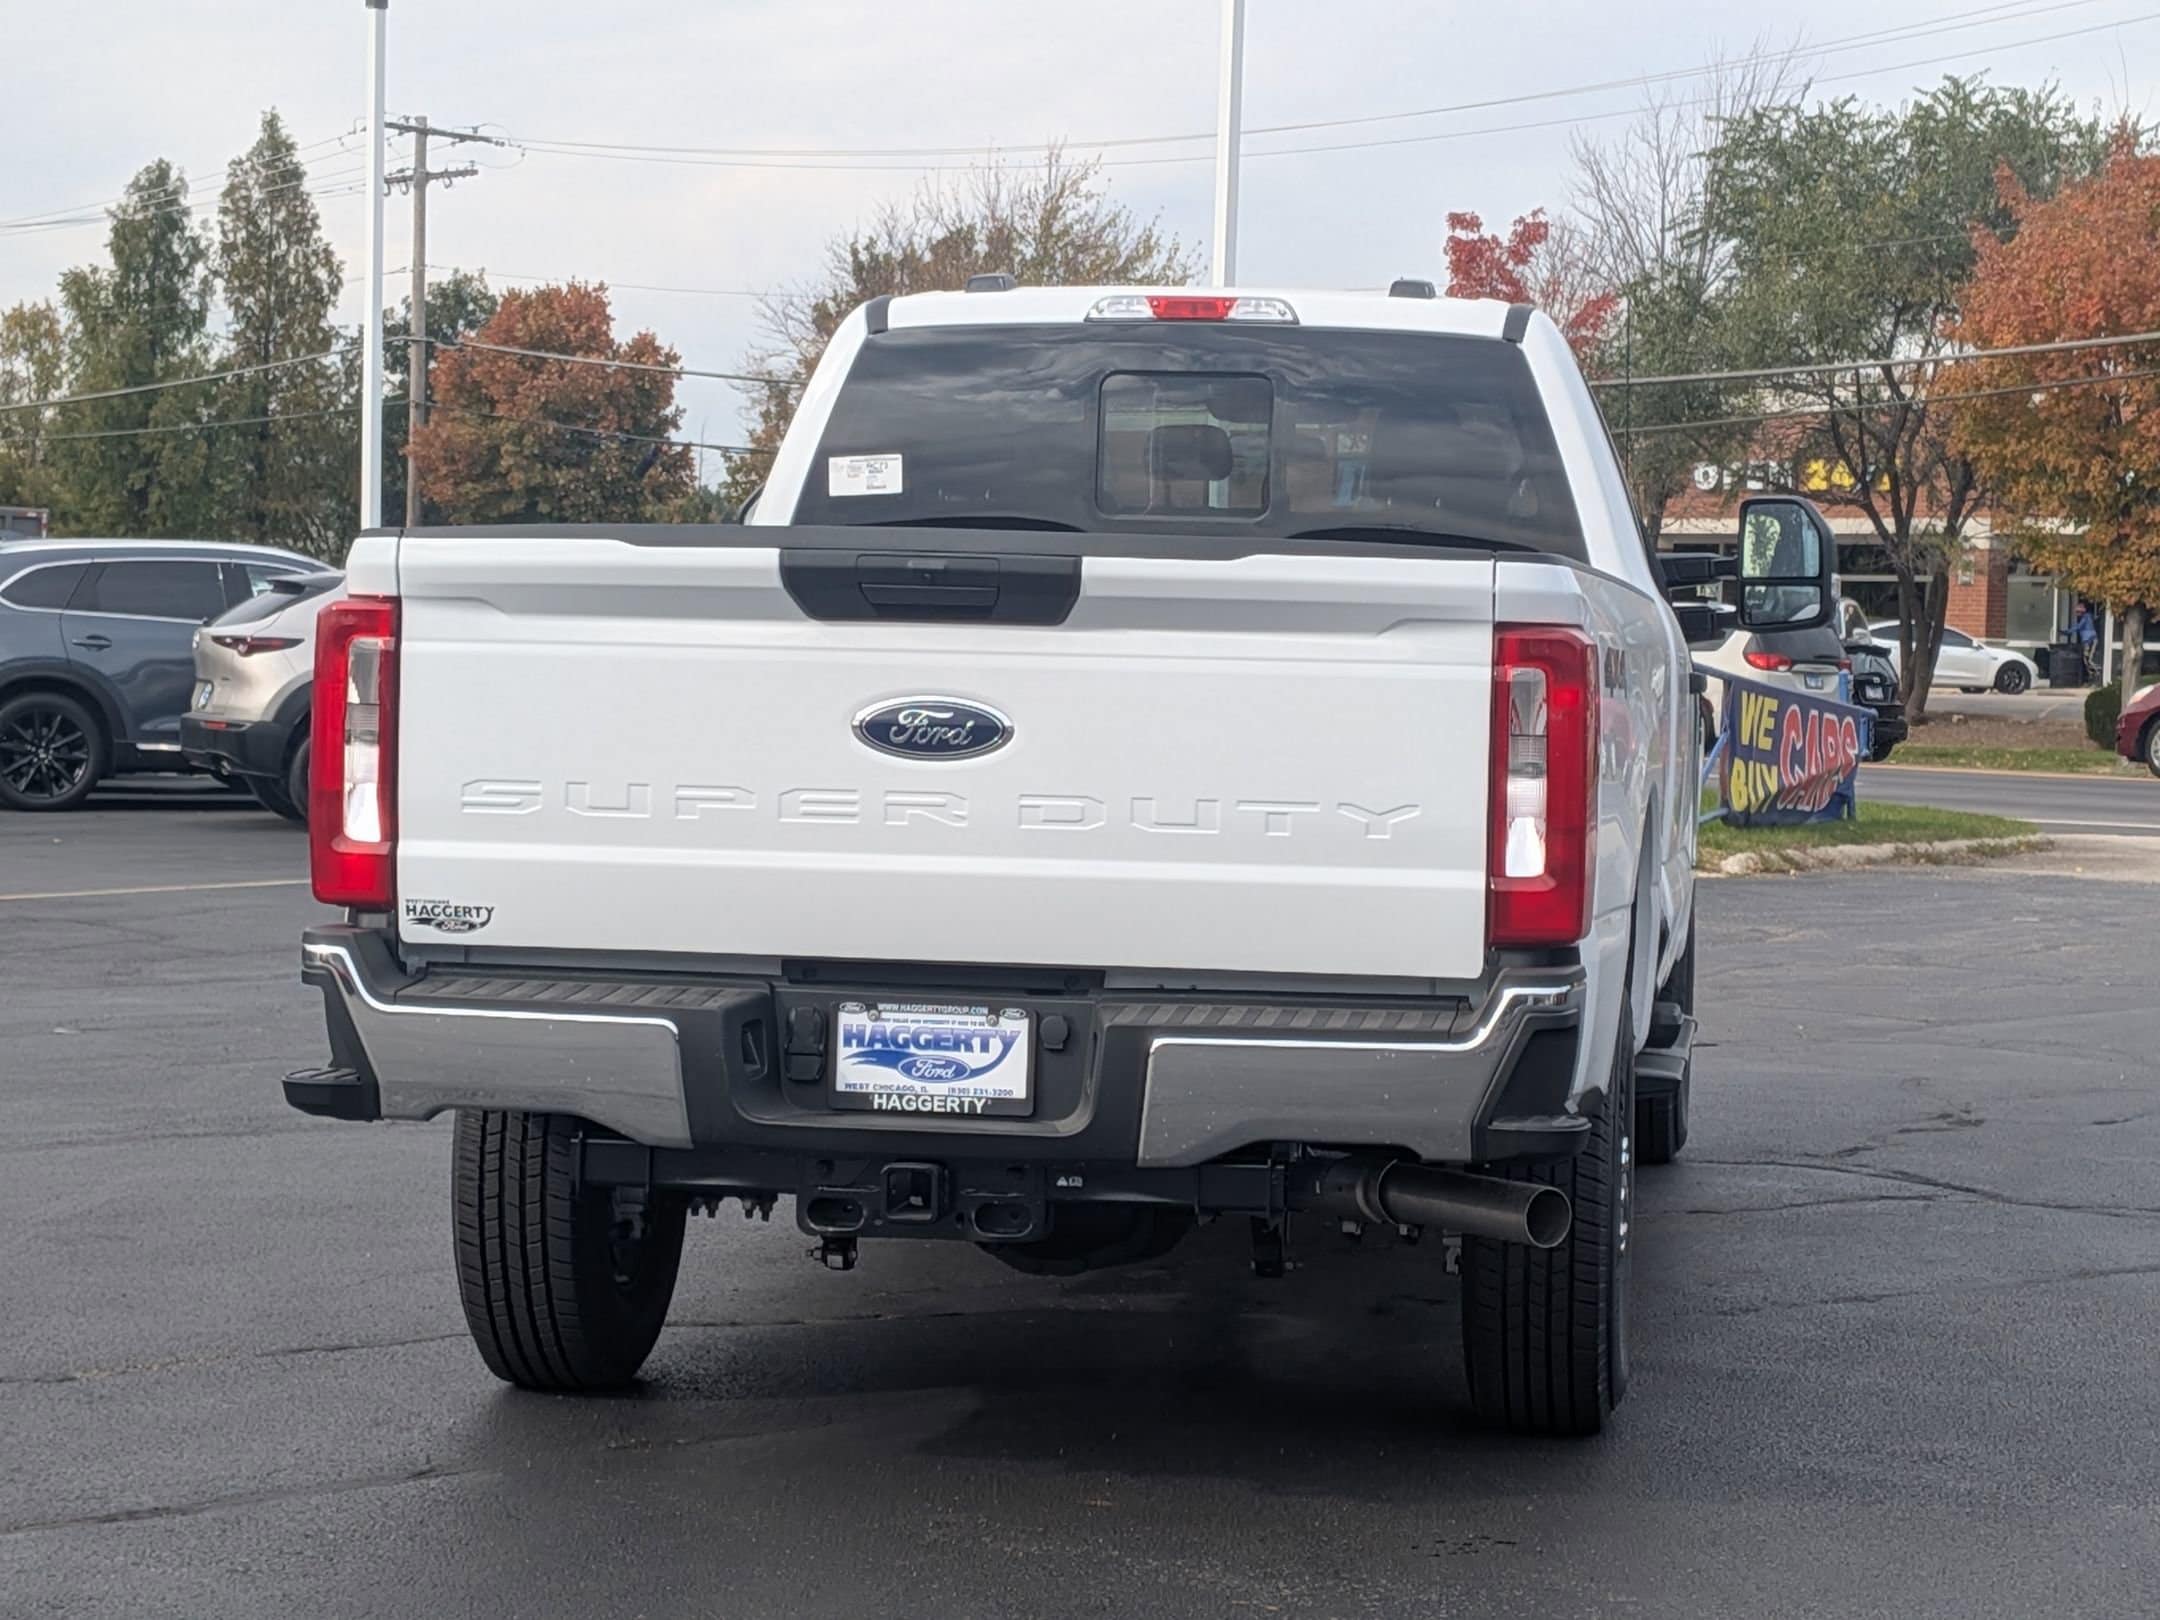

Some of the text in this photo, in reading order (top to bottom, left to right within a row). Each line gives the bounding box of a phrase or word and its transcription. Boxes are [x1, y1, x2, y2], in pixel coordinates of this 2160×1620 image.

[889, 709, 975, 745] Ford
[1741, 689, 1779, 751] WE
[1776, 703, 1859, 813] CARS
[1730, 756, 1779, 814] BUY
[461, 778, 1421, 840] SUPER DUTY
[405, 904, 495, 919] HAGGERTY
[842, 1023, 1022, 1054] HAGGERTY
[911, 1058, 956, 1079] Ford
[872, 1093, 987, 1114] HAGGERTY
